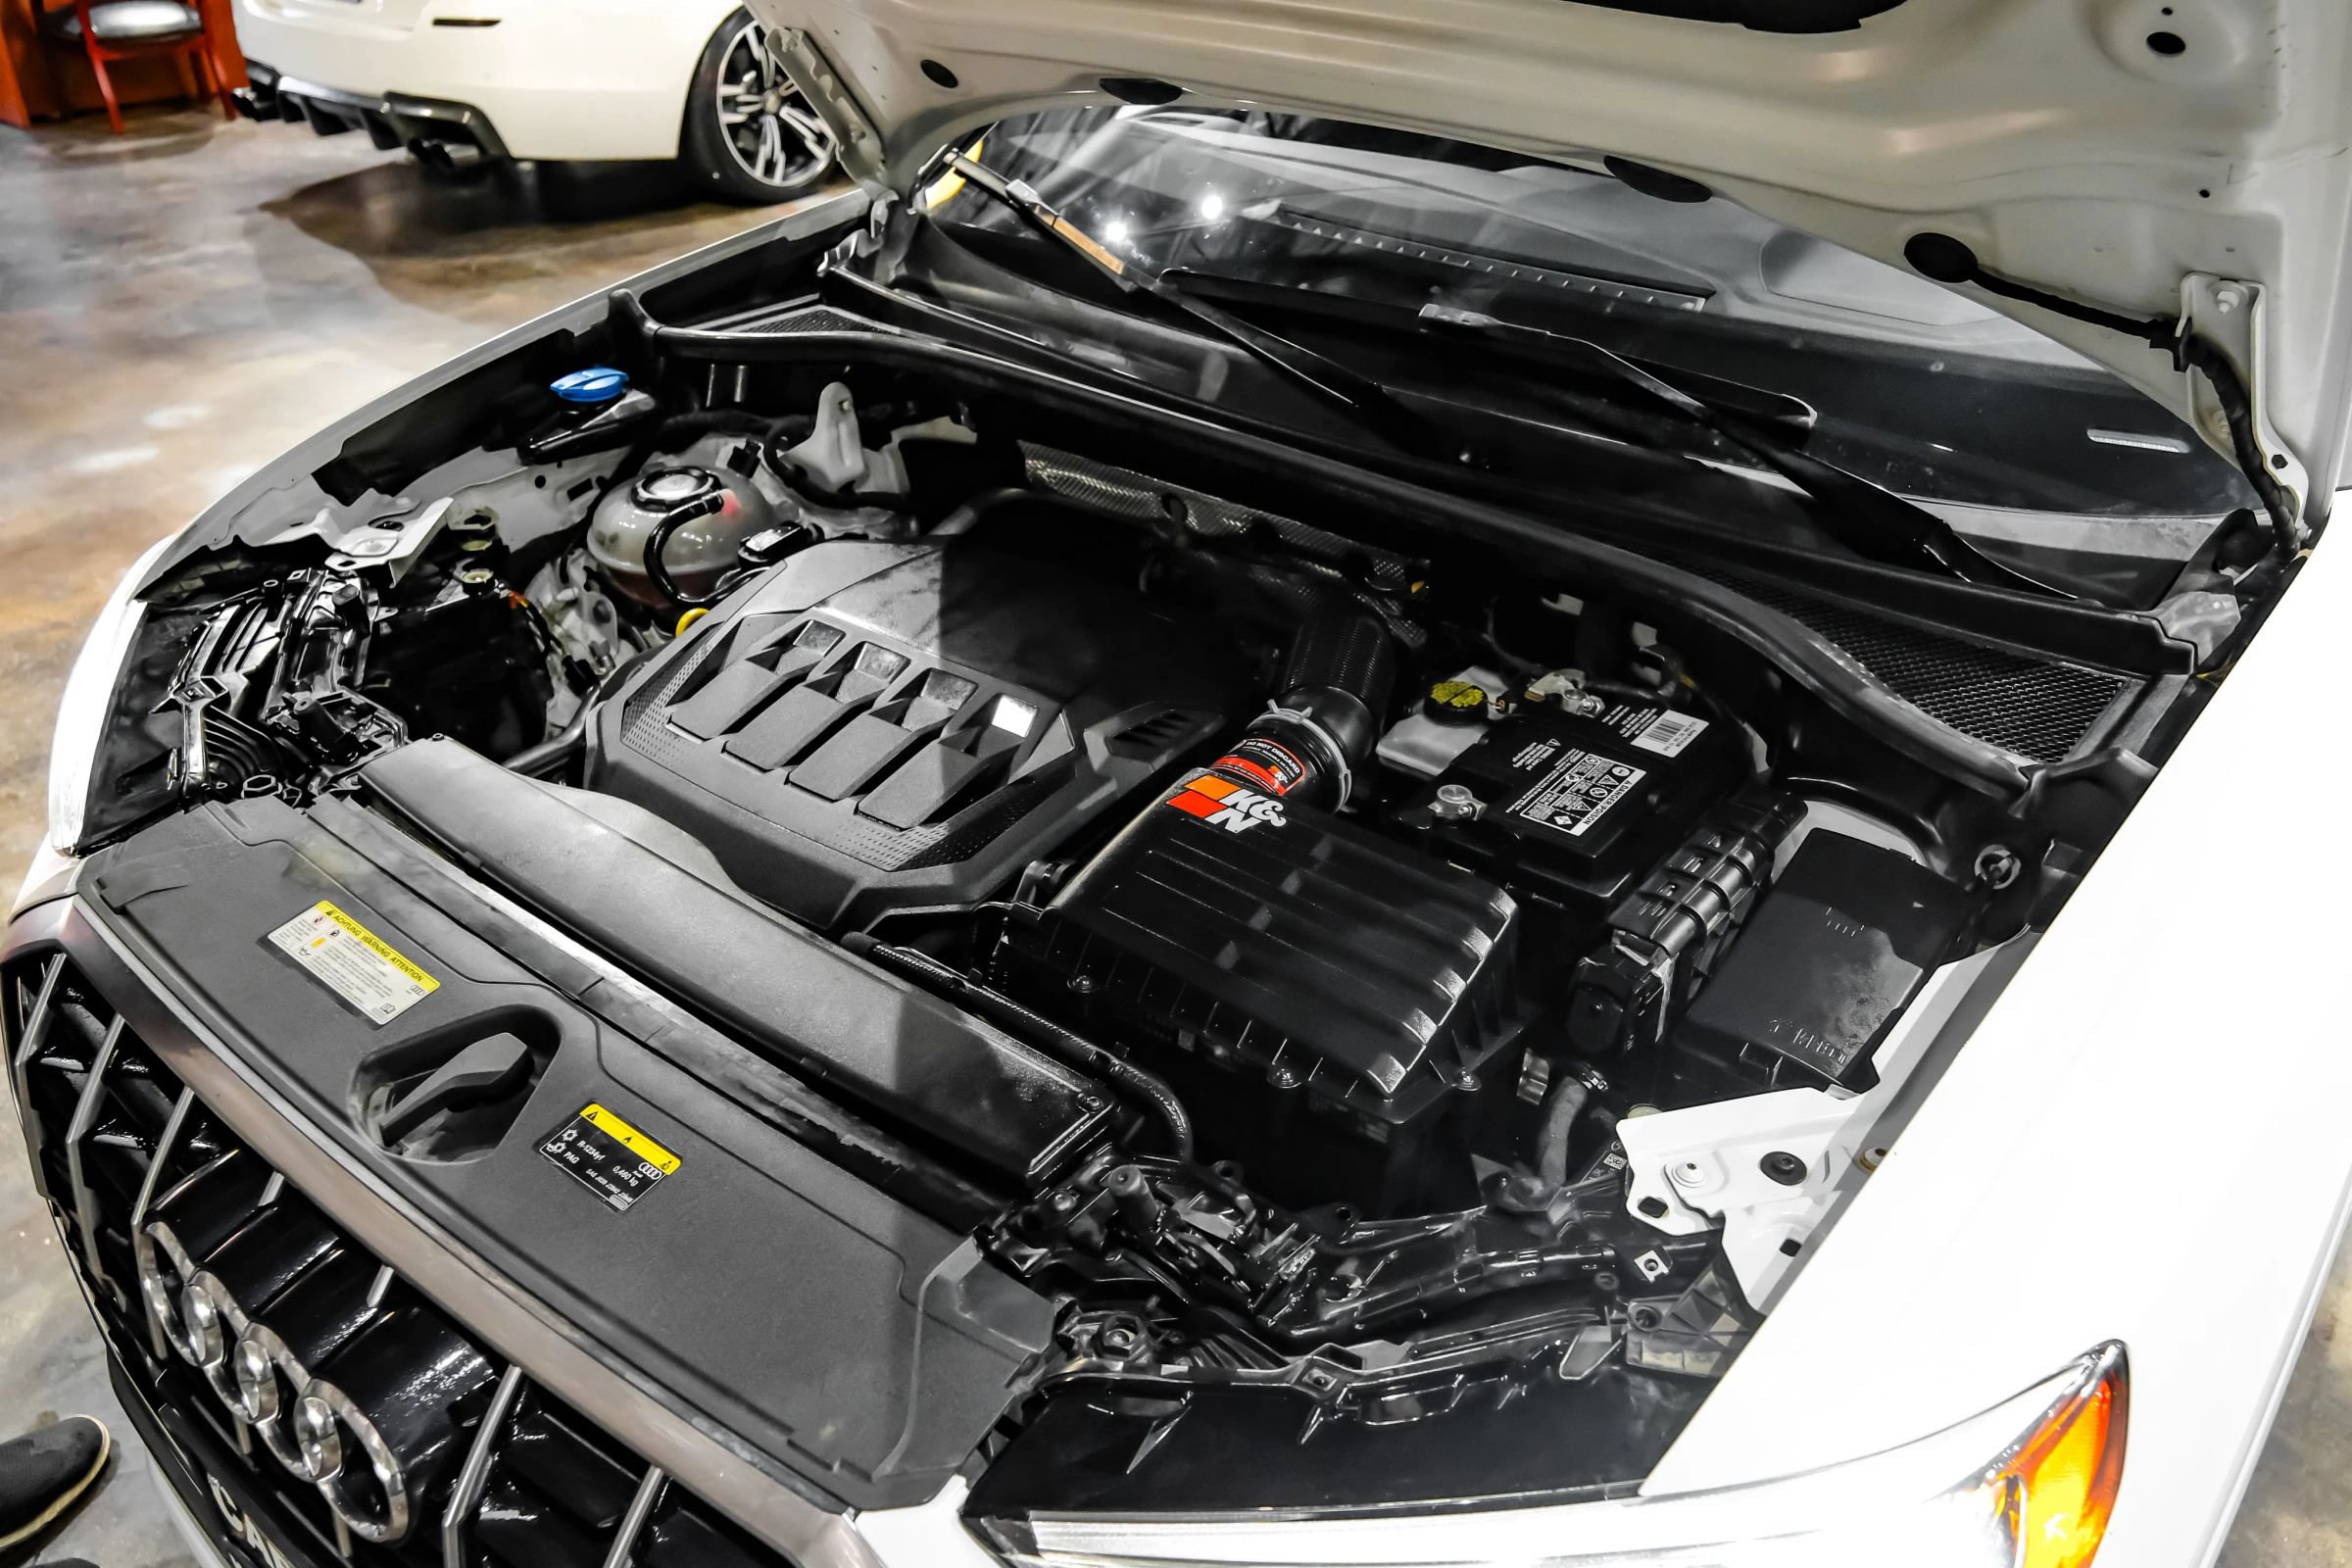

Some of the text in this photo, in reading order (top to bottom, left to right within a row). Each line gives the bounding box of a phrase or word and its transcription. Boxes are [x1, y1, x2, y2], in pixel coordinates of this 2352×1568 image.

[1271, 747, 1300, 773] DISCARD
[1204, 788, 1287, 834] K&N
[332, 914, 362, 937] ACHTUNG
[360, 935, 390, 957] WARNING
[390, 956, 423, 982] ATTENTION
[564, 1151, 580, 1164] PAG
[576, 1140, 606, 1161] R-1234yf
[628, 1176, 639, 1187] kg
